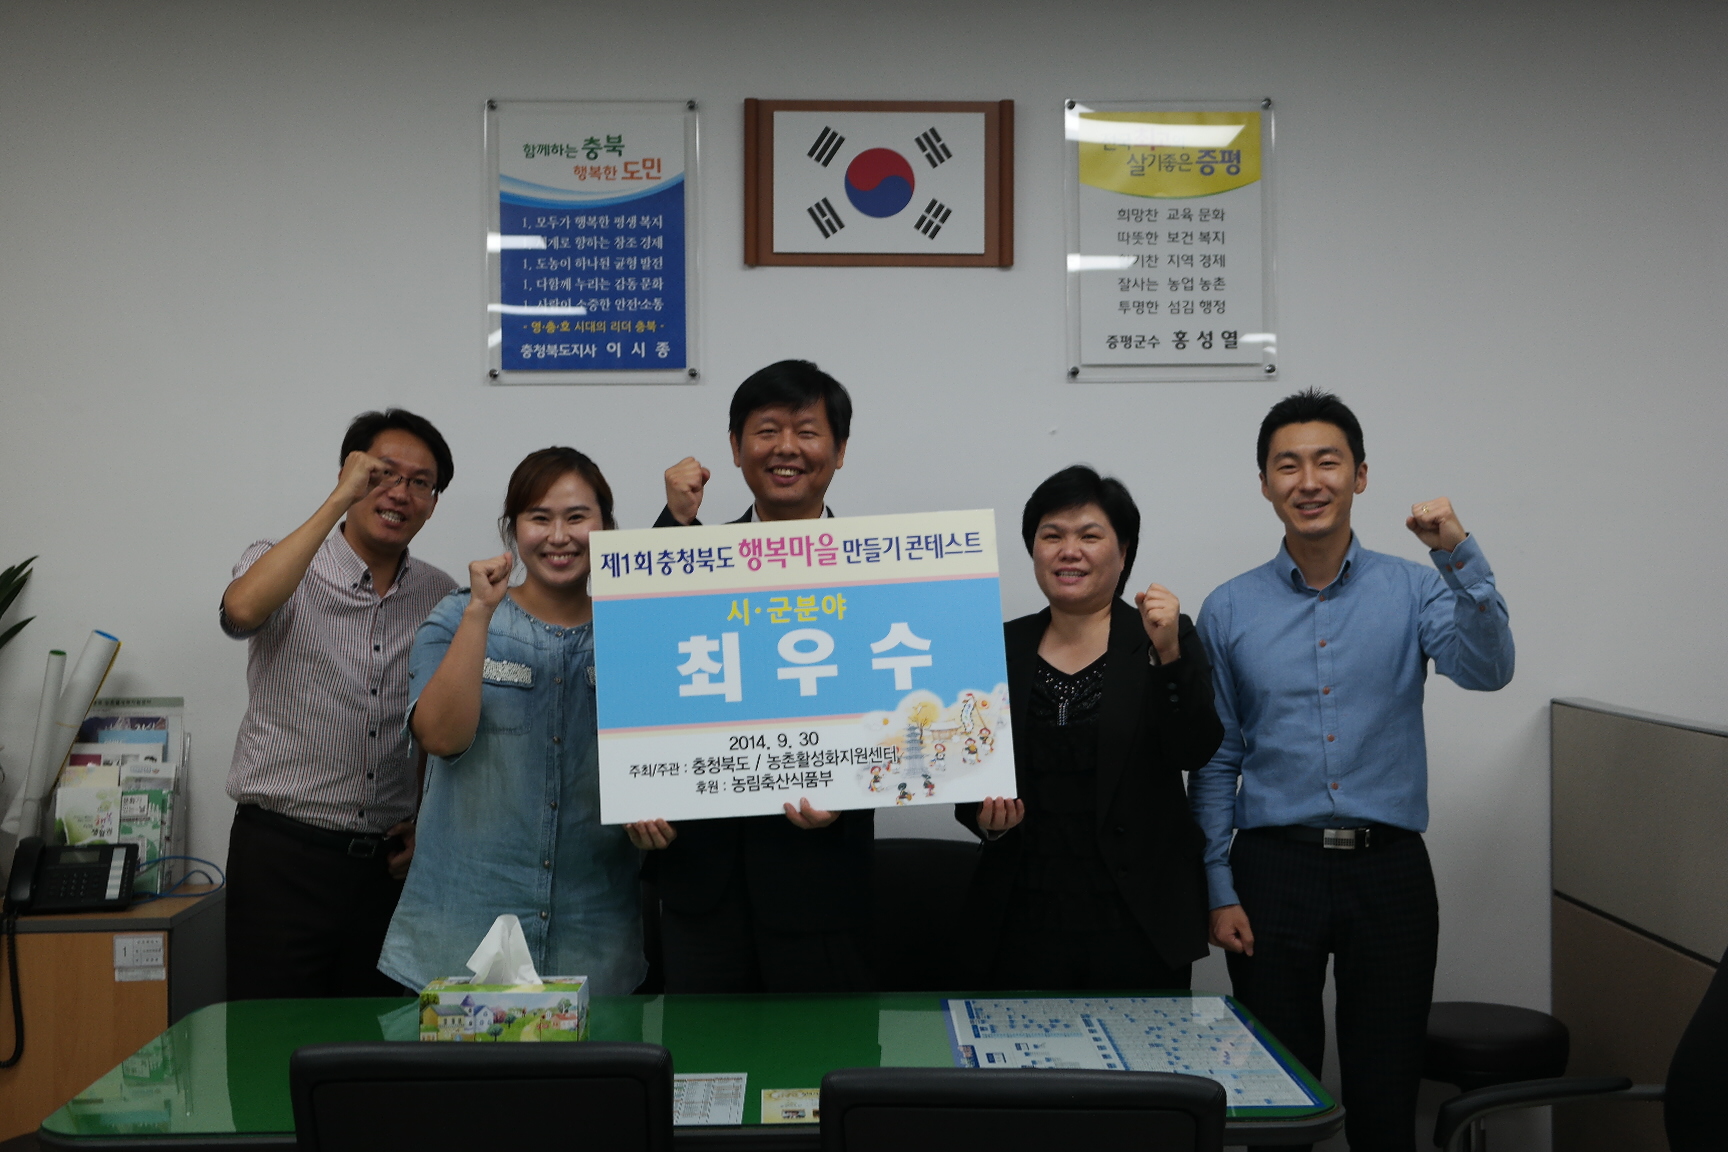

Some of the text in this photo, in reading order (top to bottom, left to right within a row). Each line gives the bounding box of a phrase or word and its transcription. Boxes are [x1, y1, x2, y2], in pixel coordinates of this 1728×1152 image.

[522, 135, 625, 160] 함께하는 충북
[574, 158, 662, 181] 행복한 도민
[1127, 149, 1241, 176] 살기좋은 증평
[536, 216, 570, 229] 모두가
[575, 216, 610, 229] 행복한
[614, 216, 637, 229] 평생
[640, 216, 663, 229] 복지
[1117, 208, 1225, 223] 희망찬 교육 문화
[575, 236, 610, 250] 향하는
[614, 236, 637, 250] 창조
[640, 236, 663, 250] 경제
[1117, 231, 1225, 245] 따뜻한 보건 복지
[536, 256, 571, 271] 도농이
[575, 256, 610, 271] 하나된
[614, 256, 637, 271] 균형
[640, 256, 663, 271] 발전
[1120, 254, 1225, 268] 기찬 지역 경제
[537, 277, 571, 292] 다함께
[575, 277, 610, 292] 누리는
[614, 277, 637, 292] 감동
[640, 277, 663, 292] 문화
[1118, 277, 1226, 292] 잘사는 농업 농촌
[1118, 300, 1226, 314] 투명한 섬김 행정
[575, 321, 606, 333] 시대의
[611, 321, 631, 333] 리더
[1106, 334, 1160, 350] 증평군수
[520, 344, 597, 358] 충청북도지사
[601, 532, 983, 578] 제1회 충청북도 행복마을 만들기 콘테스트
[799, 731, 819, 746] 30
[629, 761, 680, 778] 주최/주관
[691, 754, 750, 776] 충청북도
[767, 744, 898, 770] 농촌활성화지원센터
[696, 779, 719, 795] 후원
[731, 770, 834, 793] 농림축산식품부
